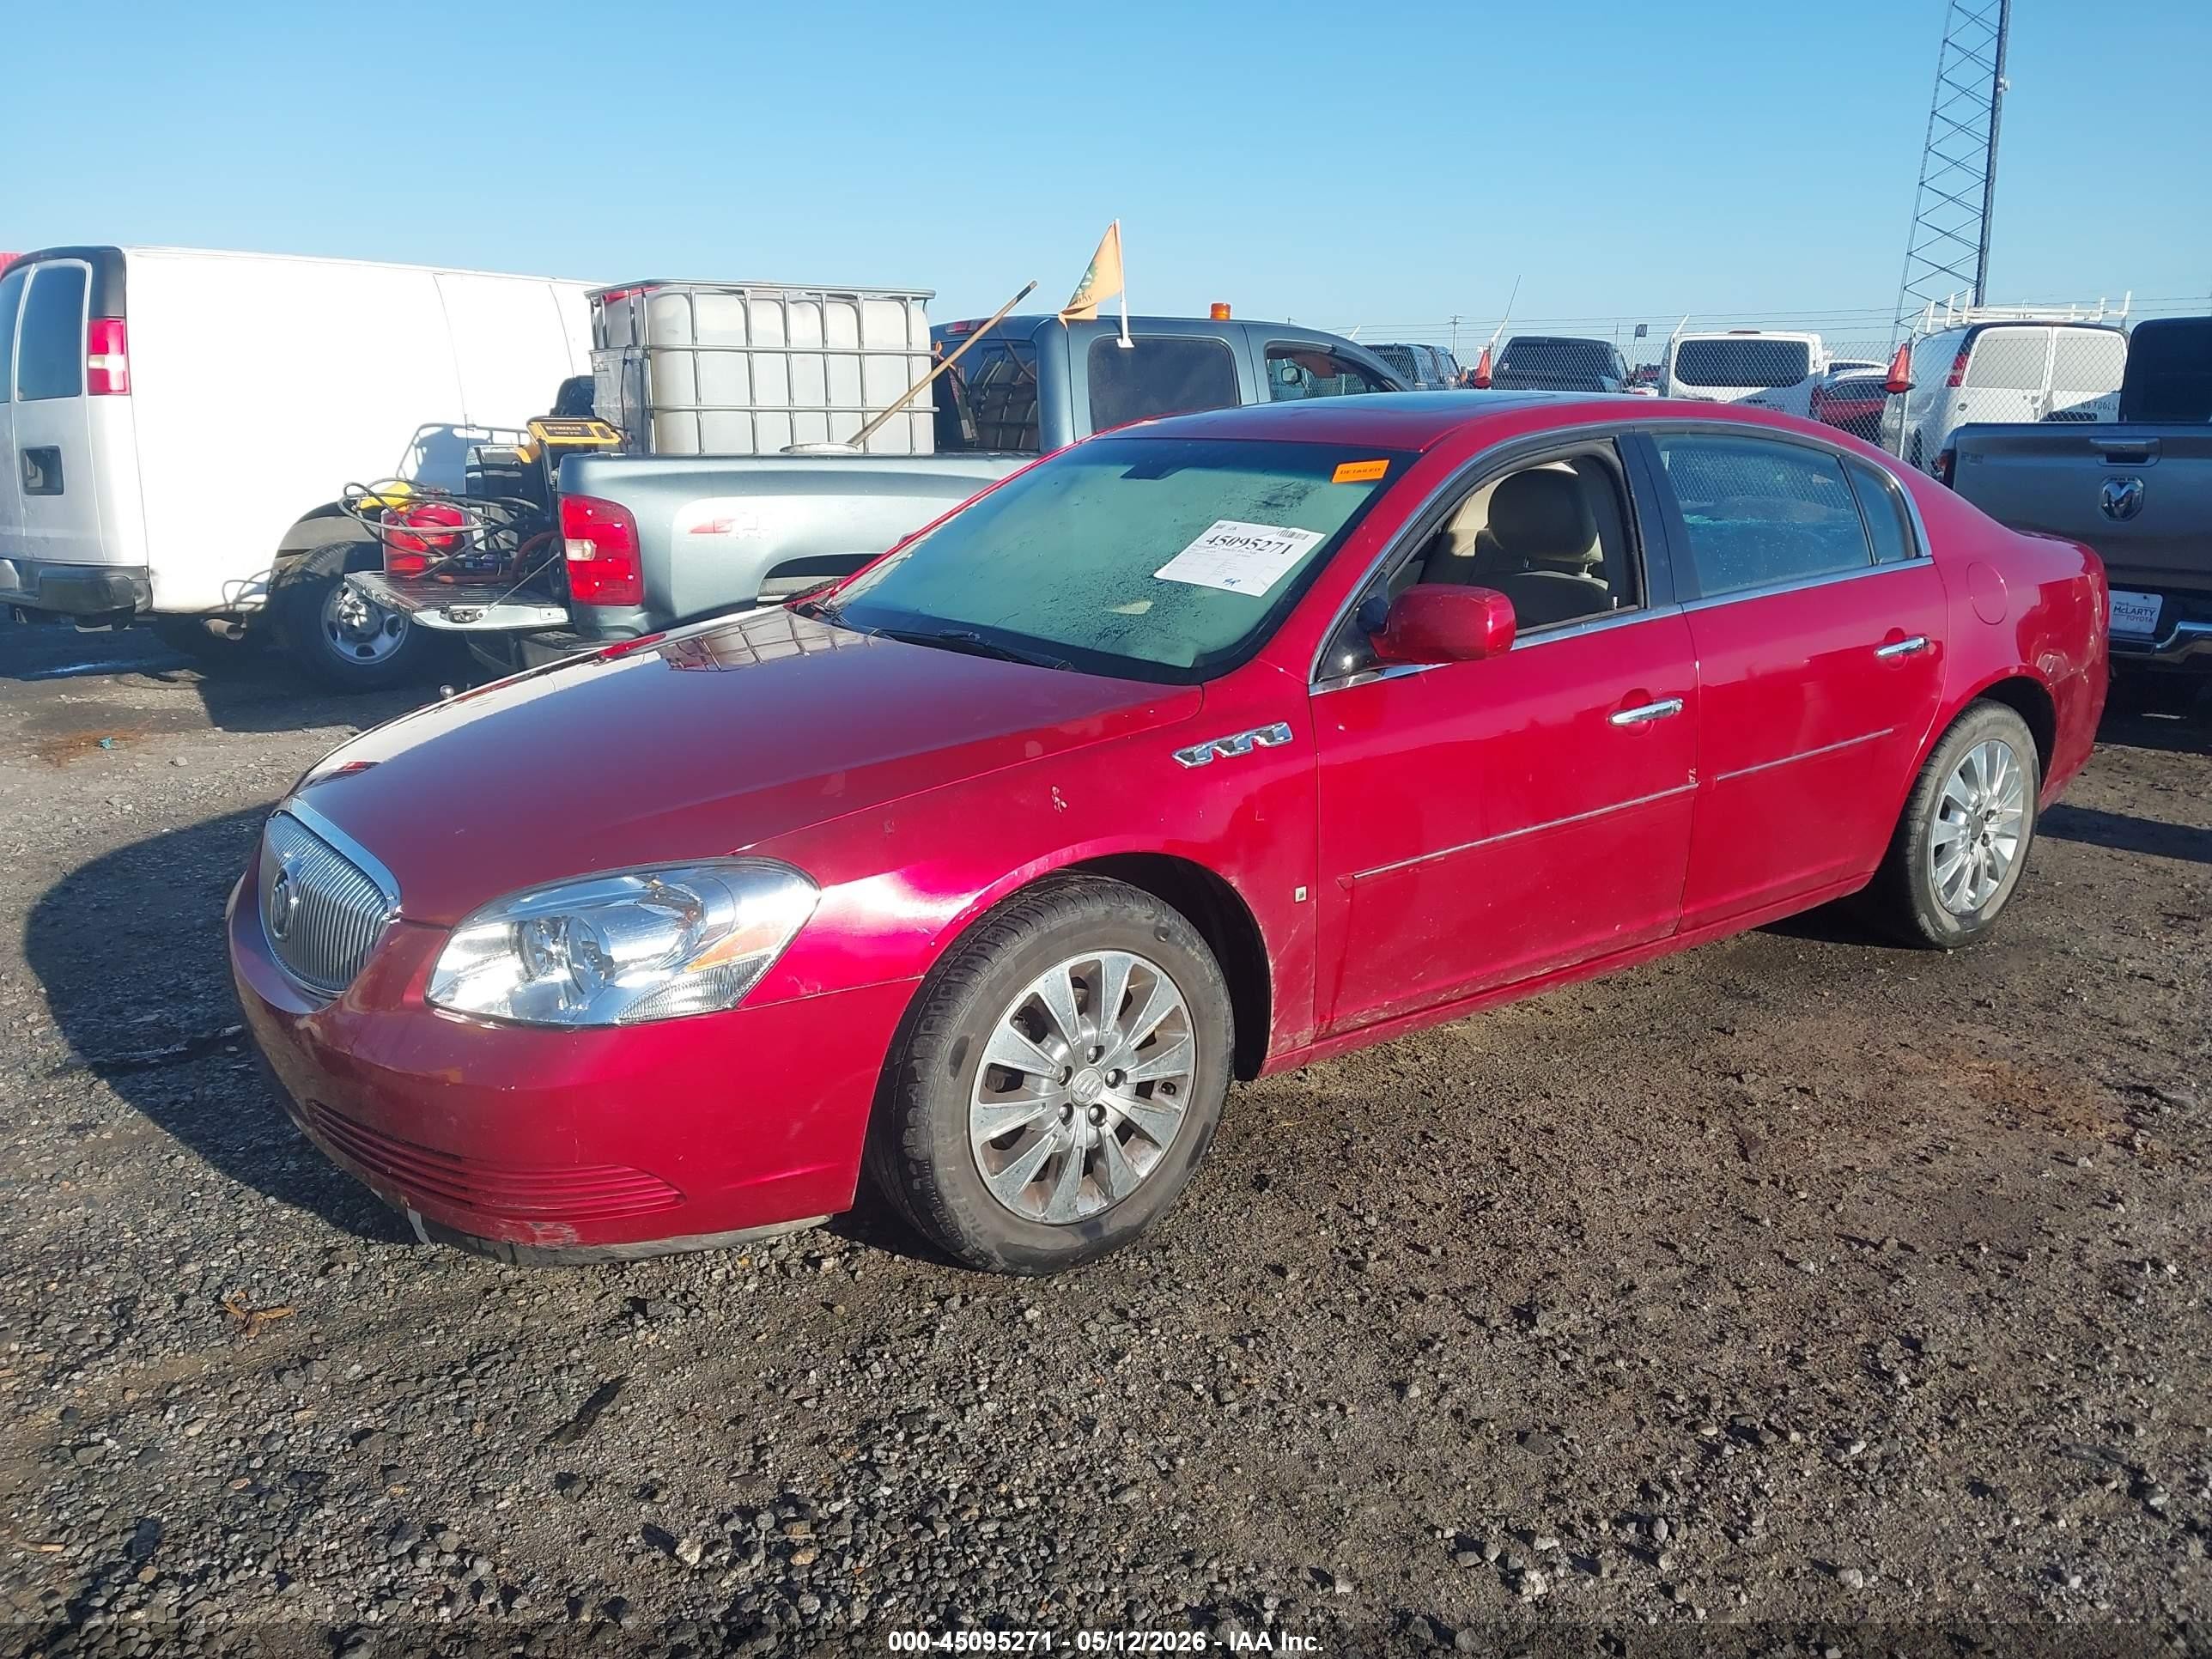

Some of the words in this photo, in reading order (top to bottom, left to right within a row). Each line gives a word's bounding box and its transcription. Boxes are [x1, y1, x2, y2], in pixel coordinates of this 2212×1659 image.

[1206, 534, 1293, 555] 45095271
[2113, 604, 2156, 617] McLARTY
[2126, 614, 2154, 623] TOYOTA
